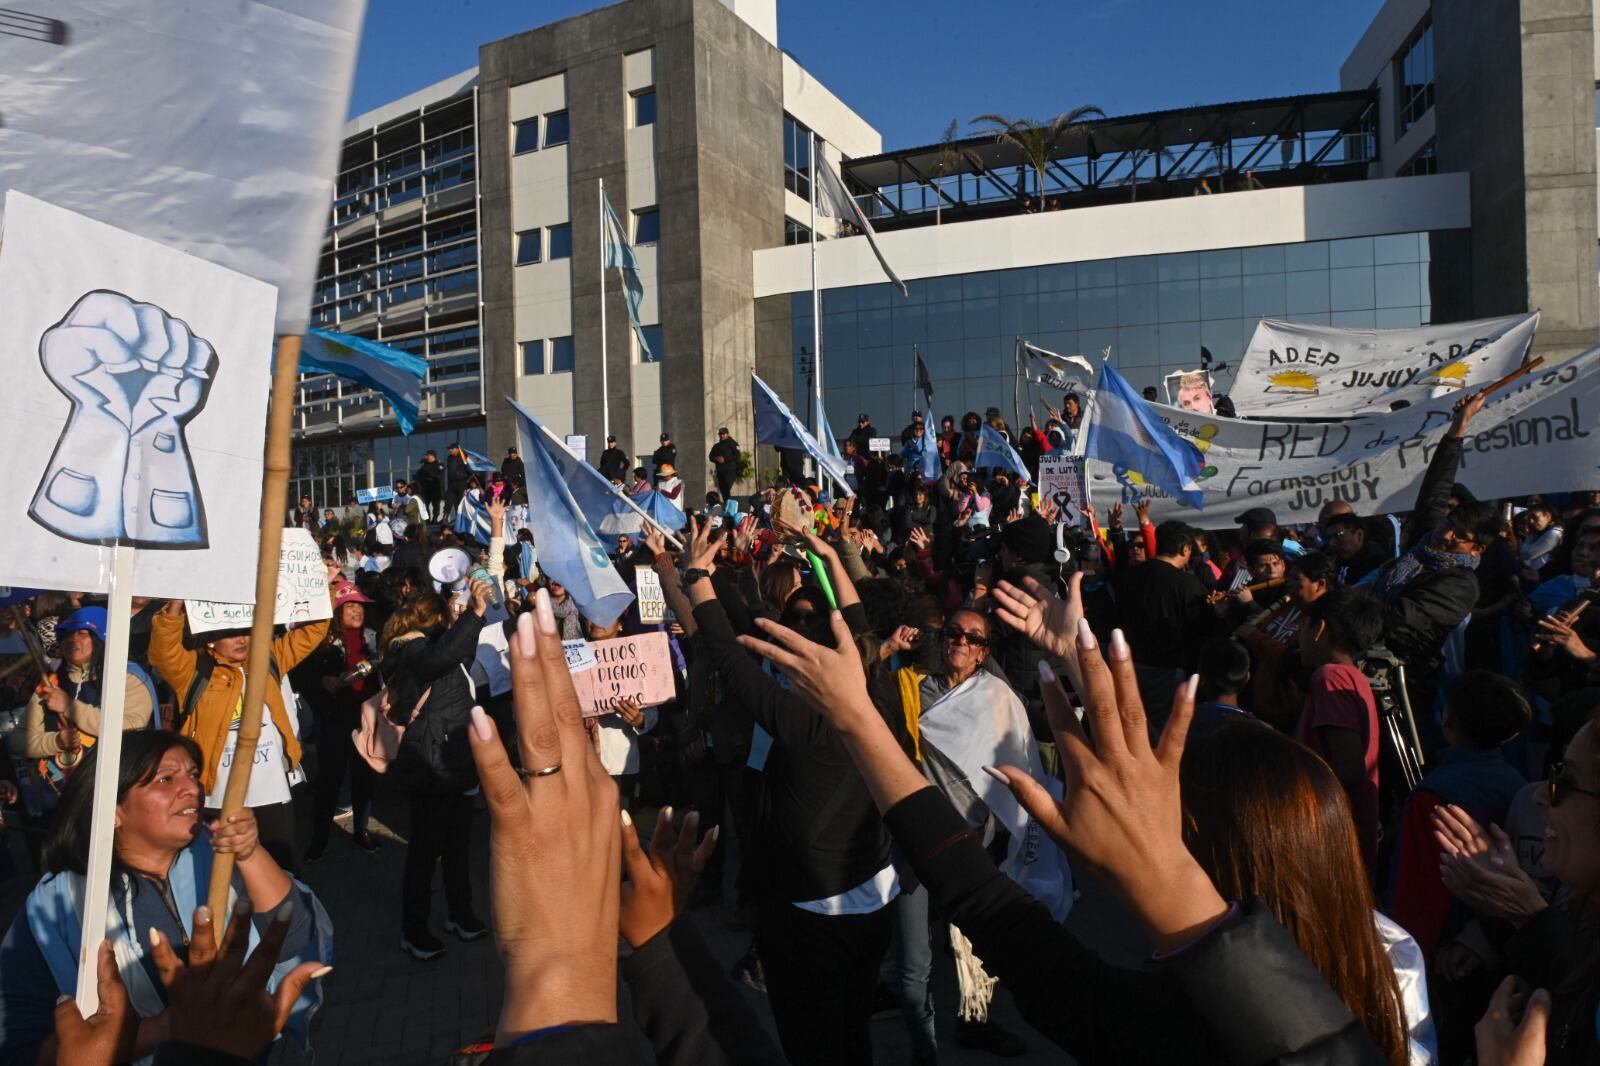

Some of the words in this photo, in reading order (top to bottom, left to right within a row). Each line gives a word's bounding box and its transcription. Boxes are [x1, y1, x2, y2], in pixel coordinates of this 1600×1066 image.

[1269, 347, 1340, 368] A.D.E.P
[1343, 368, 1420, 388] JUJUY
[1258, 424, 1350, 461] RED
[1365, 430, 1400, 450] de
[1398, 397, 1590, 469] Prfesional
[1046, 467, 1055, 475] DE
[1059, 466, 1078, 475] LUTO
[1288, 477, 1380, 511] JUJUY
[280, 550, 321, 561] EGUIMOS
[298, 563, 308, 574] LA
[644, 571, 655, 585] EL
[298, 575, 325, 588] LUCHA
[203, 607, 215, 619] el
[223, 605, 255, 619] sueld
[594, 642, 637, 664] ELDOS
[598, 662, 648, 683] DIGNOS
